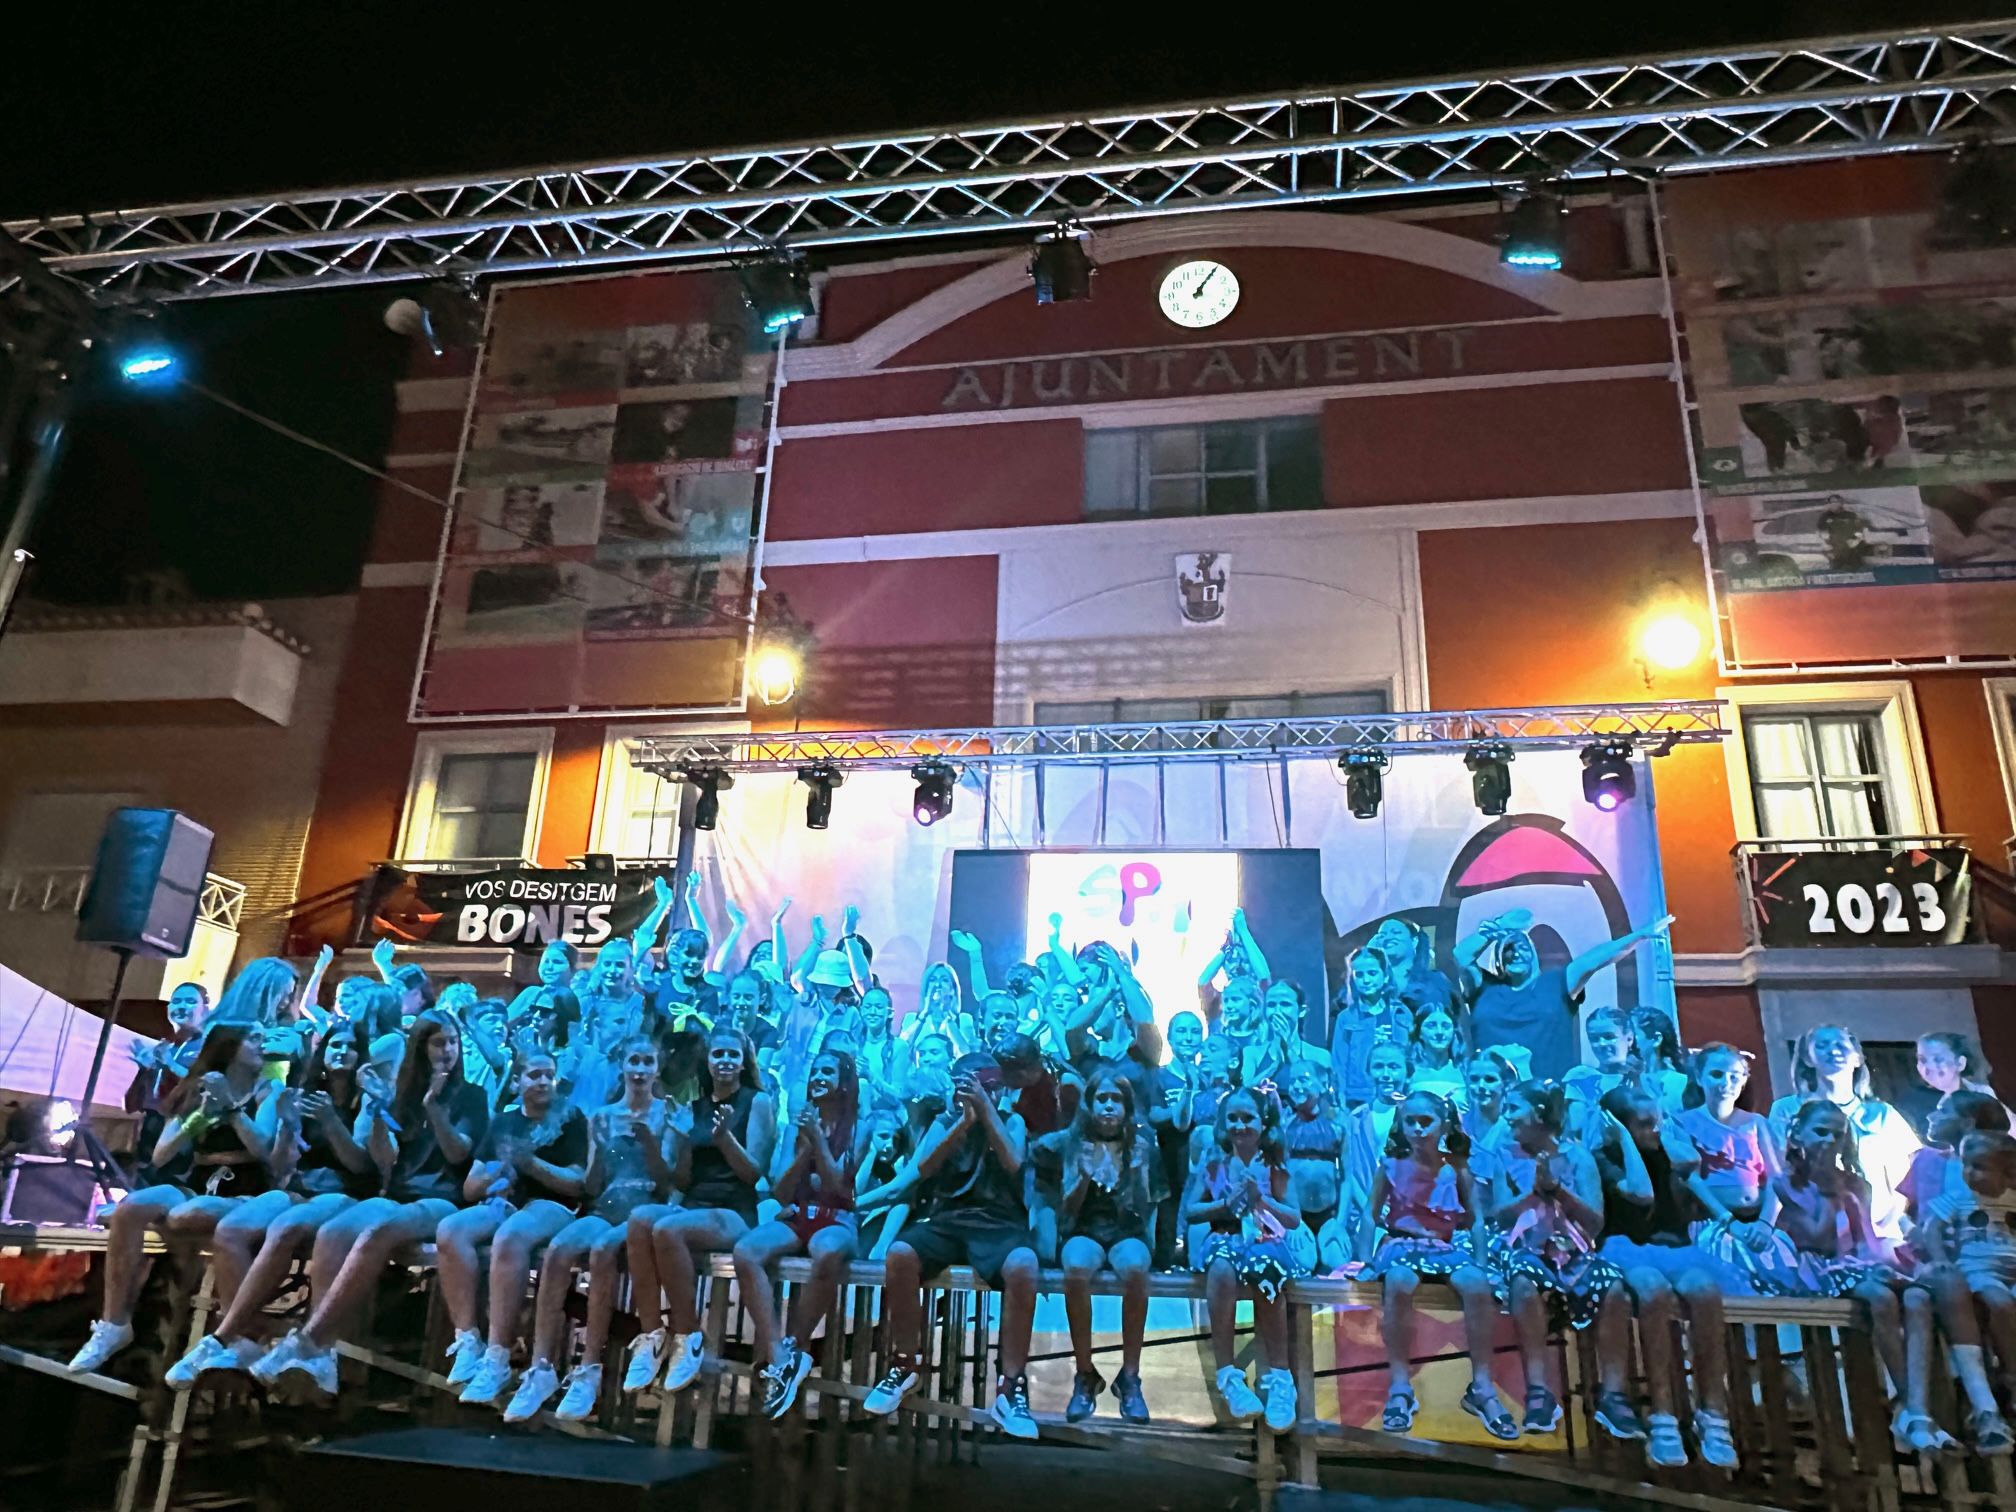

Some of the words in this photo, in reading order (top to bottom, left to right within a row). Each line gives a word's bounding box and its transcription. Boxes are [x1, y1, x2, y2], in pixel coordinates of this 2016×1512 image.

[1172, 281, 1183, 290] 10
[942, 329, 1475, 406] AJUNTAMENT
[465, 879, 506, 900] VOS
[509, 879, 618, 902] DESITGEM
[1802, 882, 1946, 934] 2023
[457, 903, 612, 945] BONES
